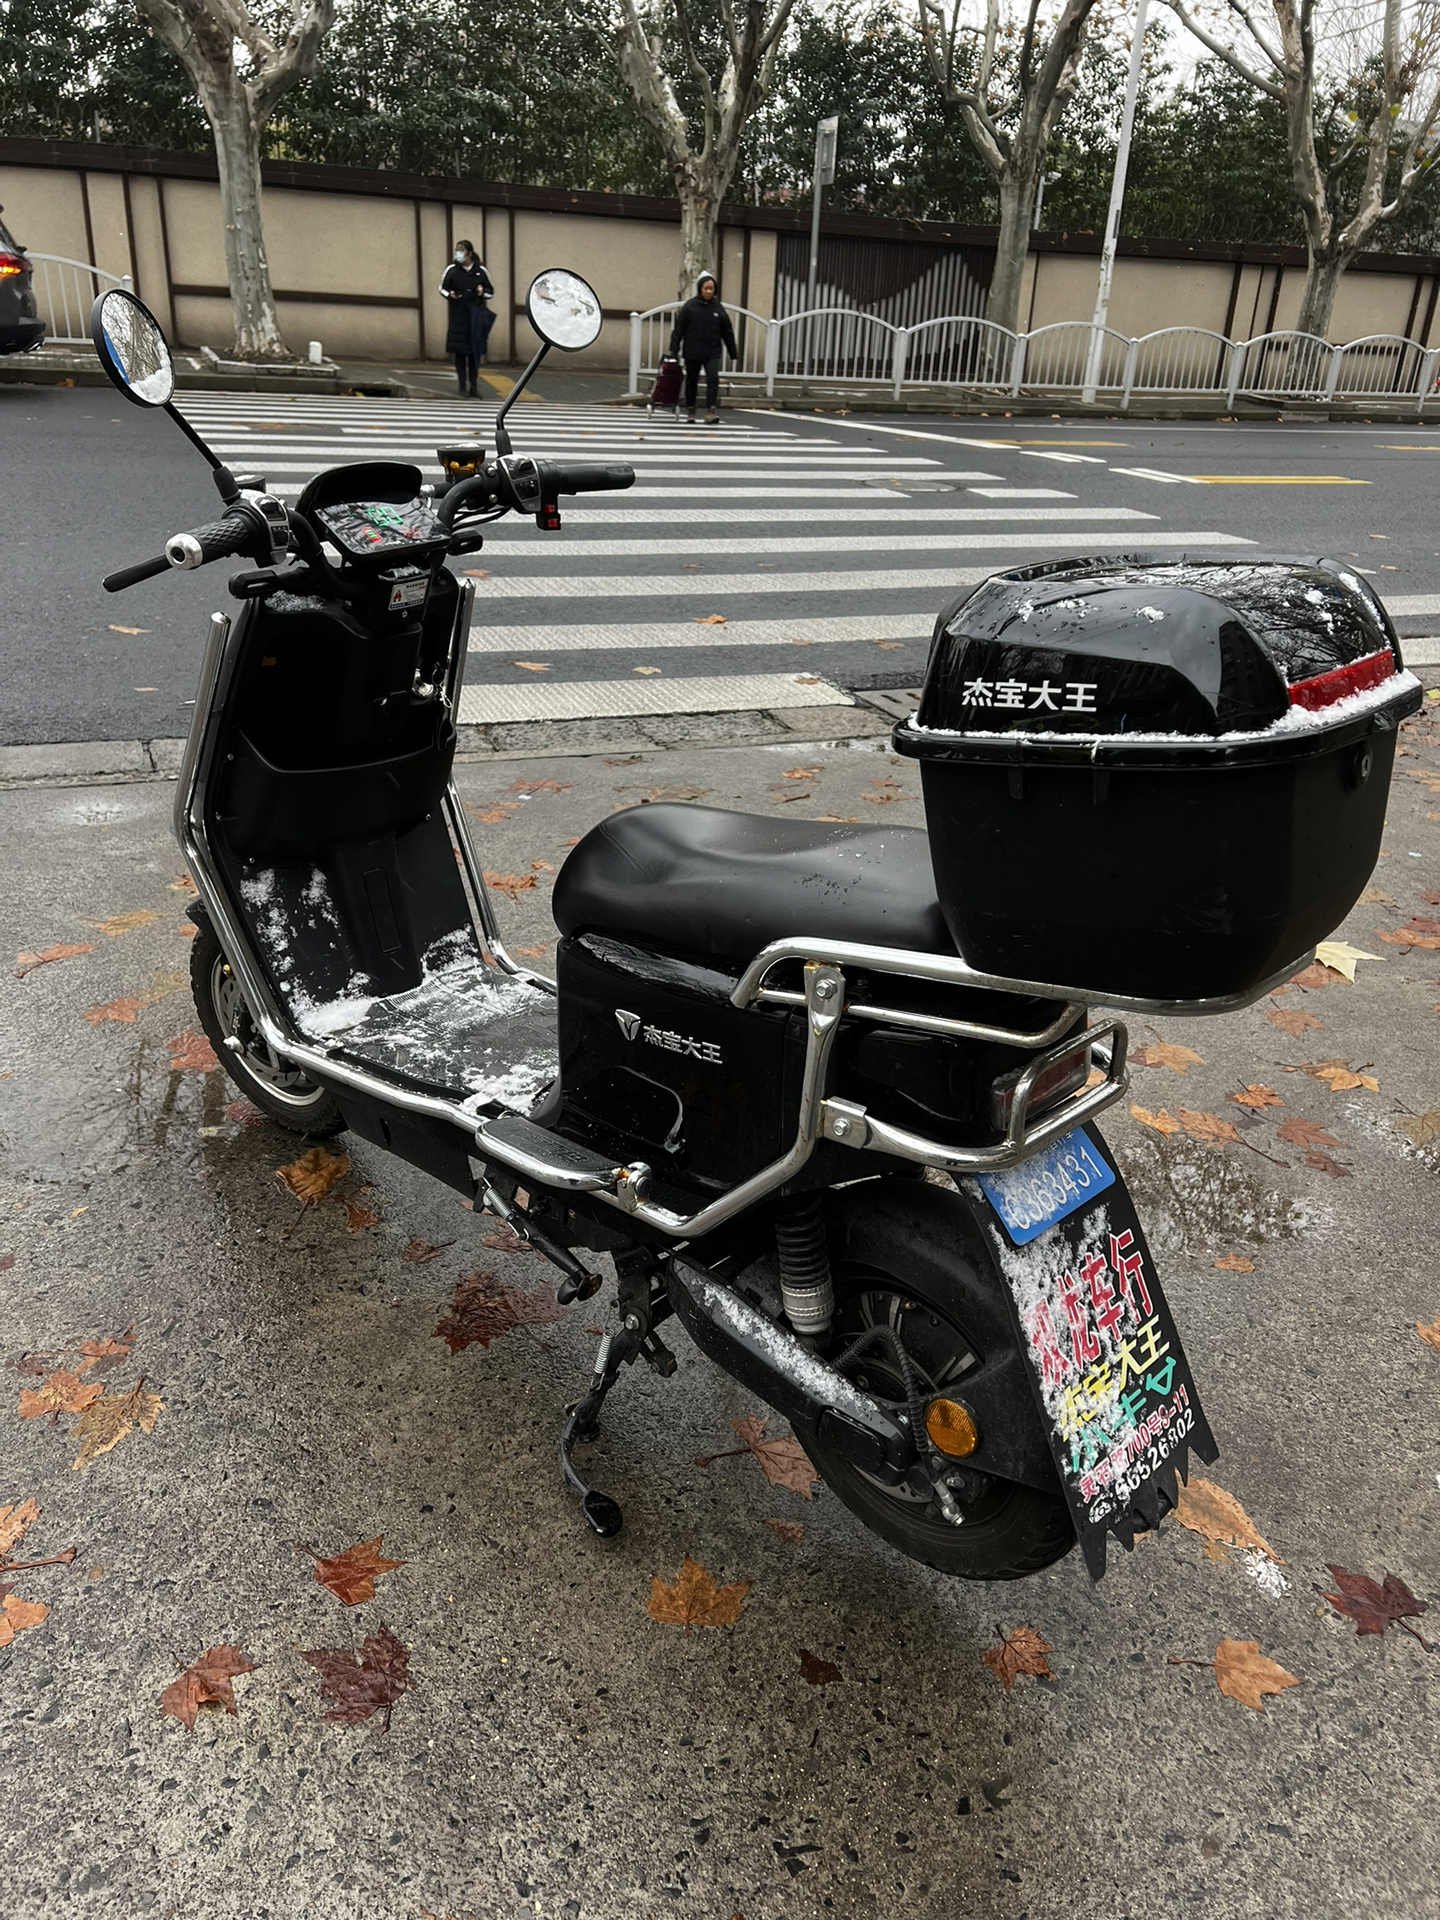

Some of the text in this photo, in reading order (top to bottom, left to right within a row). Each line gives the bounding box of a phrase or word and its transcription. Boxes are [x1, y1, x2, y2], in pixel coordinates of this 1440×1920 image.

[962, 677, 1098, 712] 杰宝大王
[643, 1025, 723, 1064] 杰宝大王
